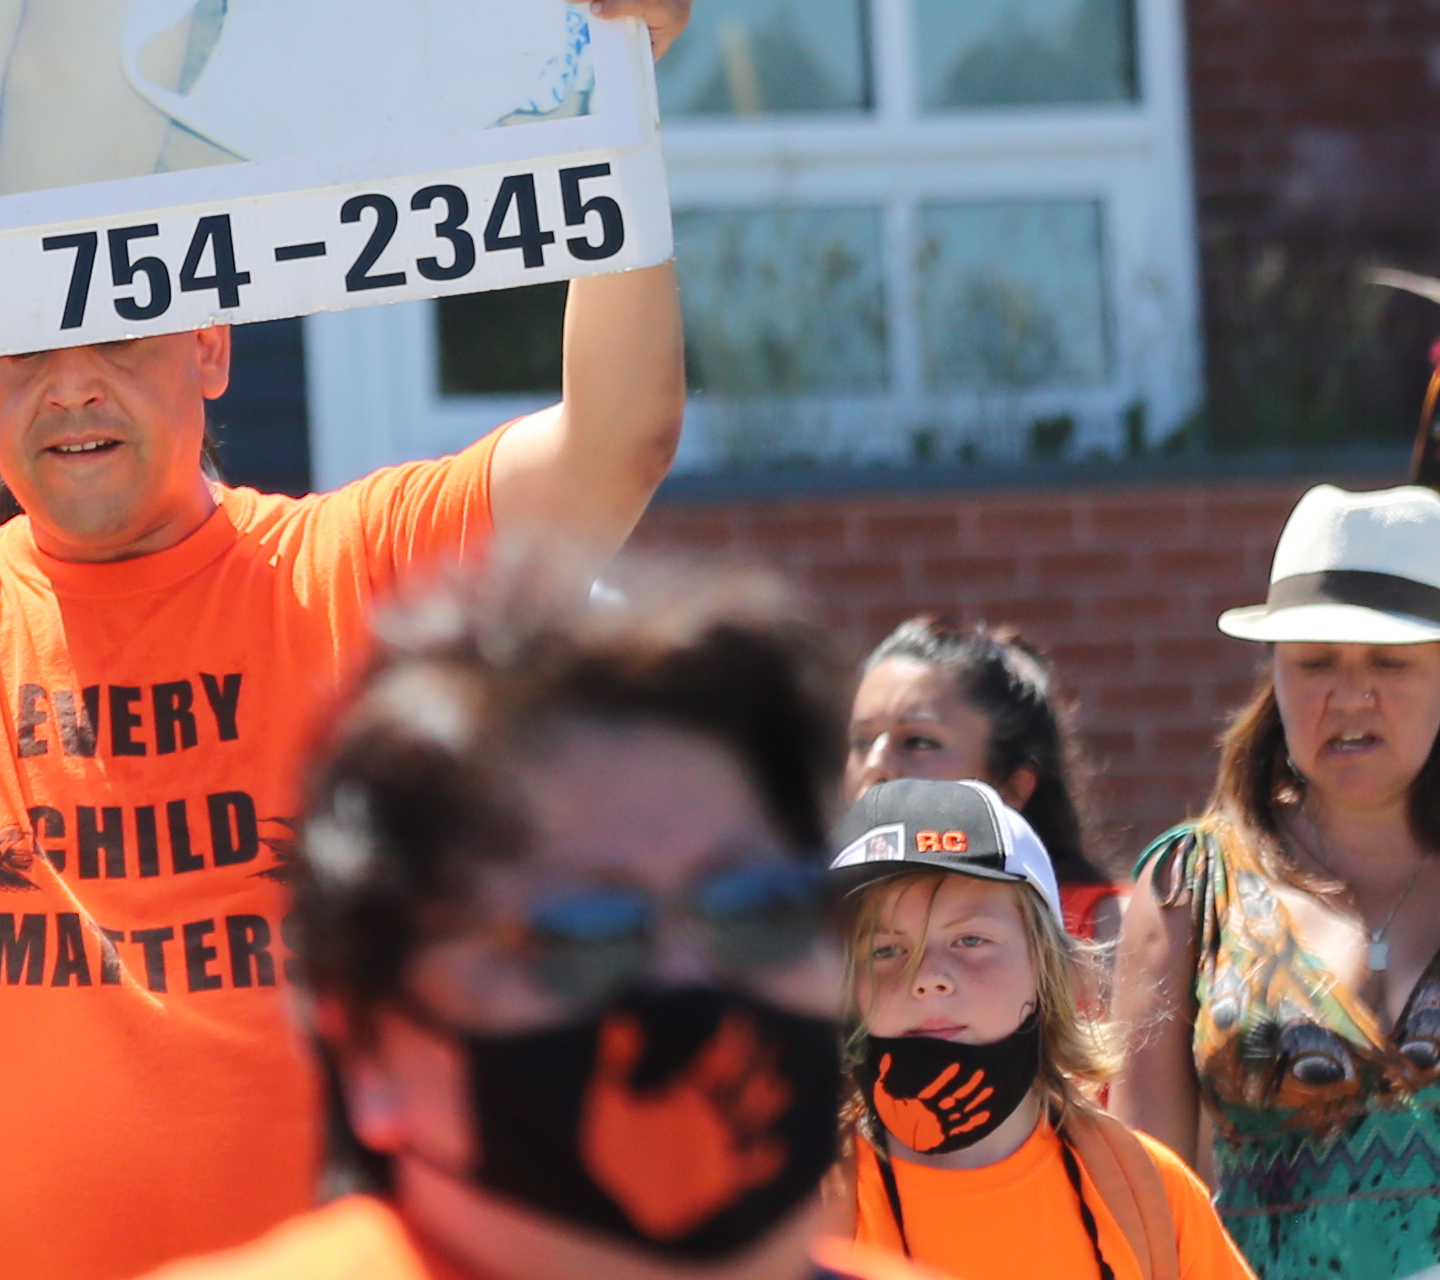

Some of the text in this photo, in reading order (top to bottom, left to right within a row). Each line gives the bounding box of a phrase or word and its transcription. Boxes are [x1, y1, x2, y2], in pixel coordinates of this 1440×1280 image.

[42, 162, 627, 332] 754-2345
[16, 672, 243, 759] EVERY
[26, 790, 260, 880] CHILD
[915, 829, 969, 853] RC
